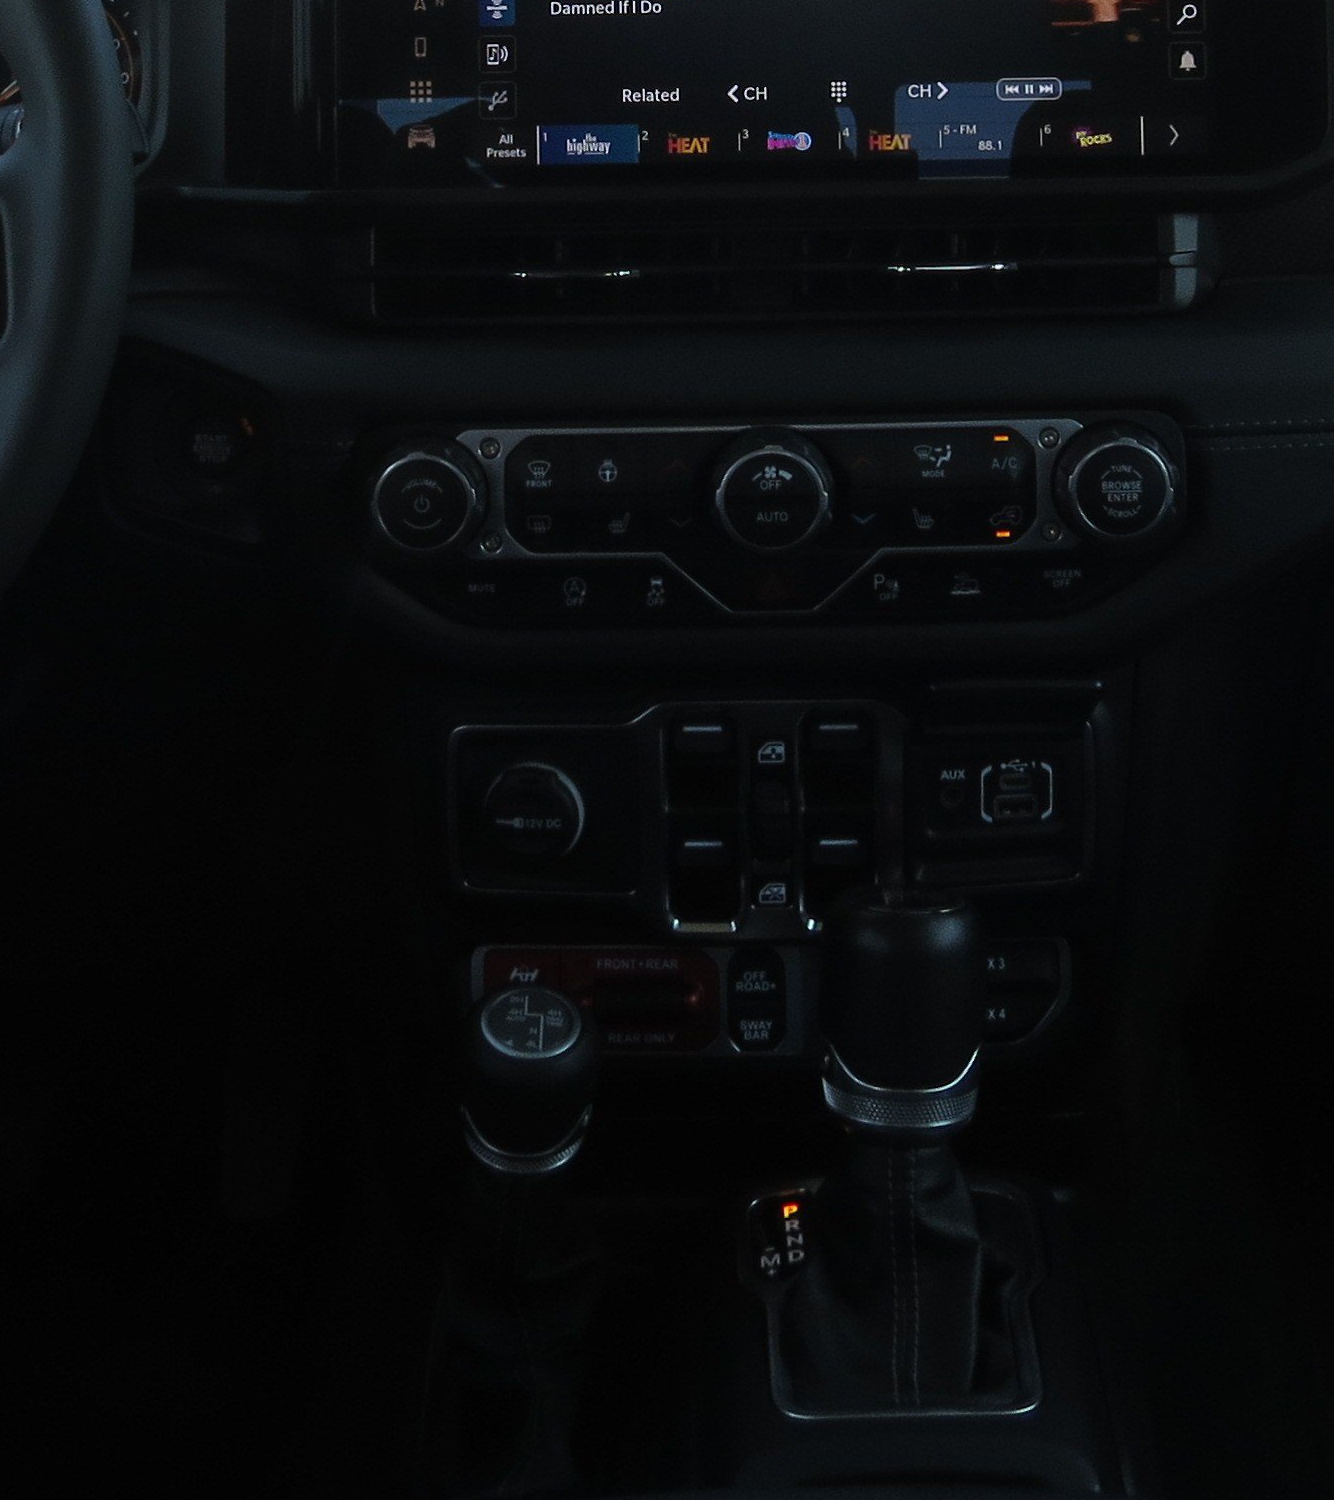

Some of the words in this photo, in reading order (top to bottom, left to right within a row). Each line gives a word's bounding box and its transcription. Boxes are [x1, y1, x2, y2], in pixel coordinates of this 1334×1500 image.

[550, 0, 614, 15] Damned
[640, 0, 662, 14] Do
[622, 87, 680, 102] Related
[744, 87, 767, 101] CH
[907, 84, 932, 98] CH
[742, 130, 749, 139] 3
[842, 127, 850, 137] 4
[959, 124, 977, 135] FM
[1044, 124, 1051, 134] 6
[499, 134, 513, 144] All
[642, 131, 649, 141] 2
[869, 133, 911, 151] HEAT
[566, 138, 611, 155] highway
[667, 137, 710, 154] HEAT
[978, 139, 1002, 151] 88.1
[486, 147, 527, 160] Presets
[759, 479, 783, 492] OFF
[1101, 480, 1143, 491] BROWSE
[1107, 493, 1139, 503] ENTER
[755, 511, 789, 523] AUTO
[467, 583, 496, 593] MUTE
[940, 769, 966, 780] AUX
[743, 970, 767, 981] OFF
[739, 1019, 774, 1031] SWAY
[743, 1030, 770, 1041] BAR
[782, 1203, 799, 1219] P
[785, 1219, 800, 1233] R
[786, 1233, 804, 1247] N
[760, 1252, 781, 1269] M
[788, 1248, 805, 1263] D
